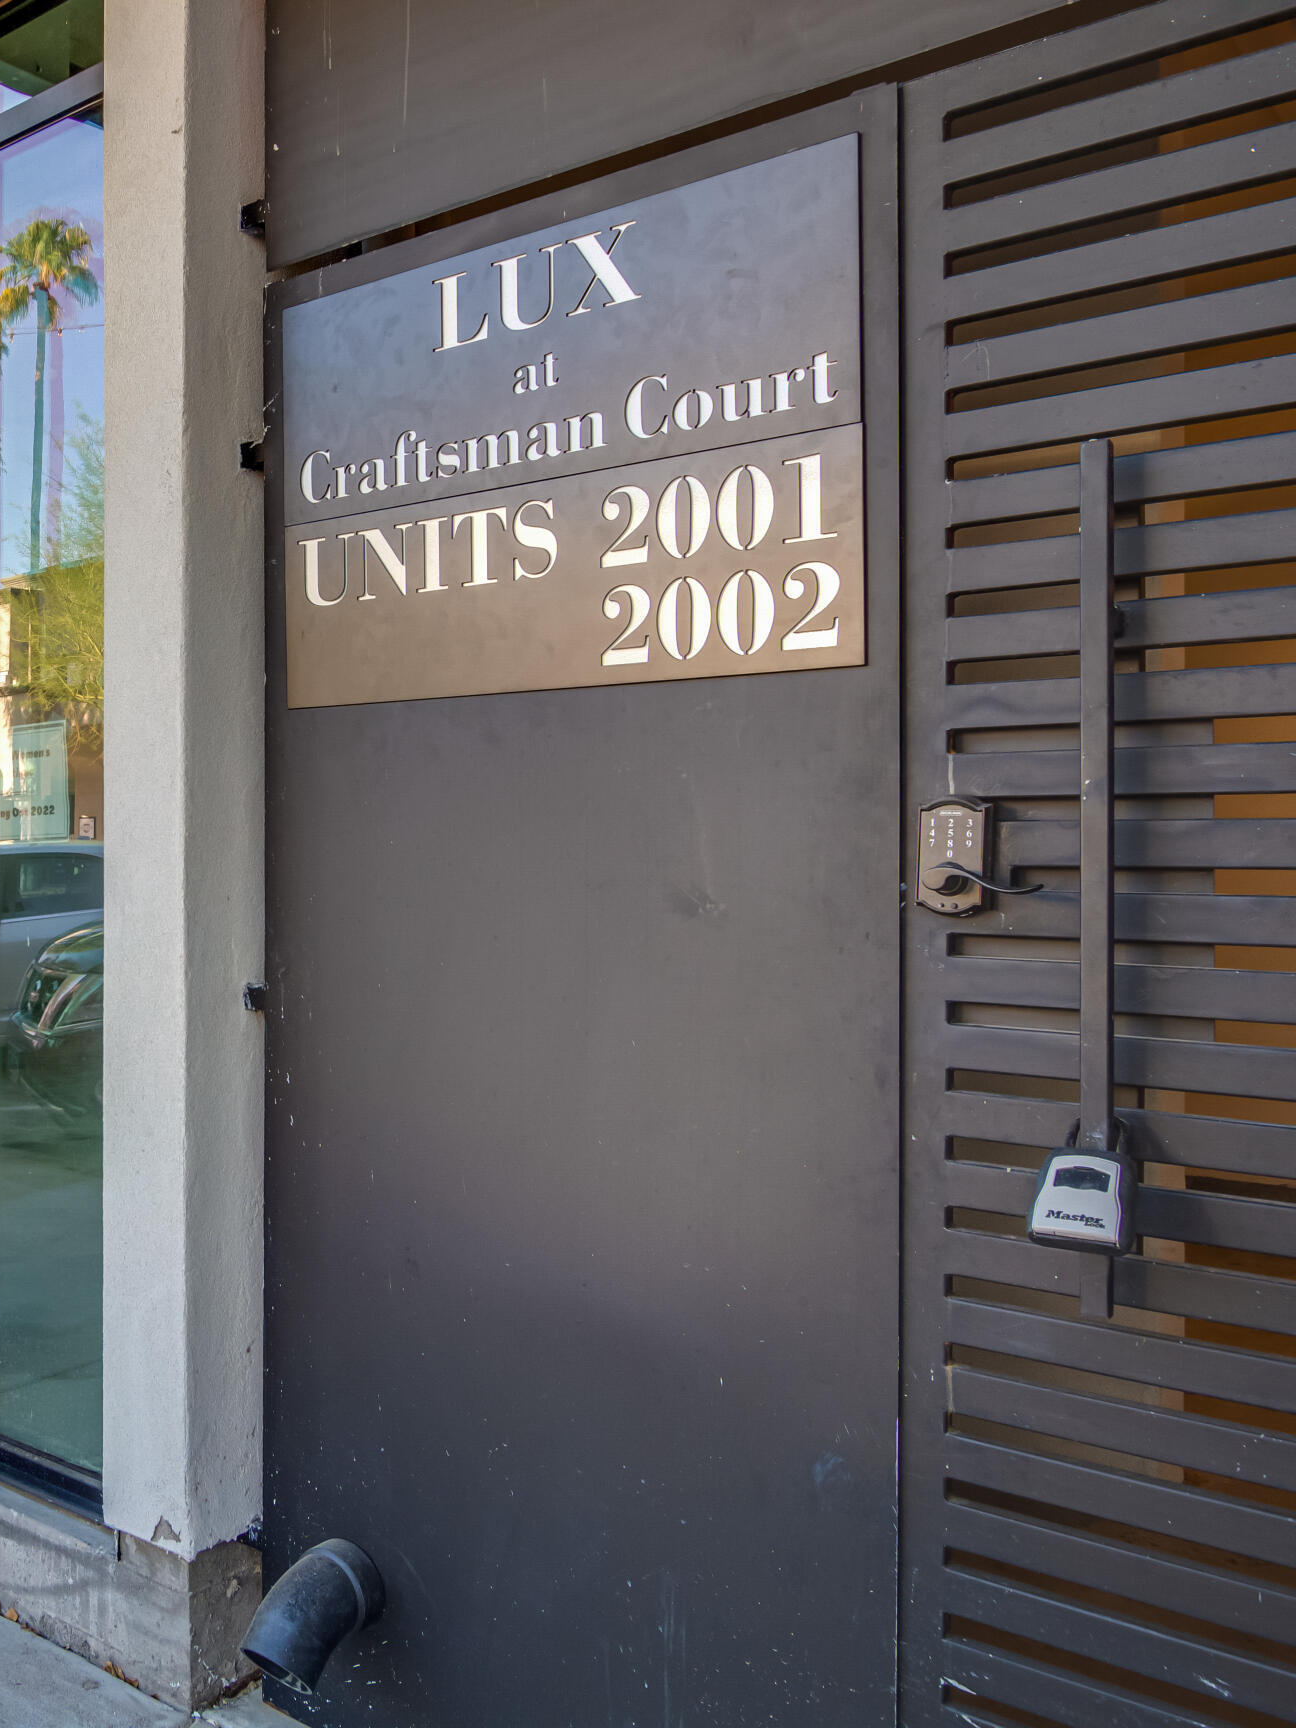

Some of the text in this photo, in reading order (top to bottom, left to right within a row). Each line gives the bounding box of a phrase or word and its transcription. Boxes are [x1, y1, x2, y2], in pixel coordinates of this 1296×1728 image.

[432, 220, 643, 353] LUX
[511, 351, 560, 395] at
[299, 350, 840, 505] Craftsman Court
[297, 452, 839, 608] UNITS 2001
[600, 560, 842, 668] 2002
[30, 804, 55, 816] 2022
[948, 819, 954, 827] 2
[966, 819, 973, 827] 3
[929, 829, 972, 837] 4 5 6
[929, 839, 972, 848] 7 8 9
[947, 850, 953, 858] 0
[1045, 1209, 1104, 1223] Master
[1084, 1221, 1105, 1229] Lock
